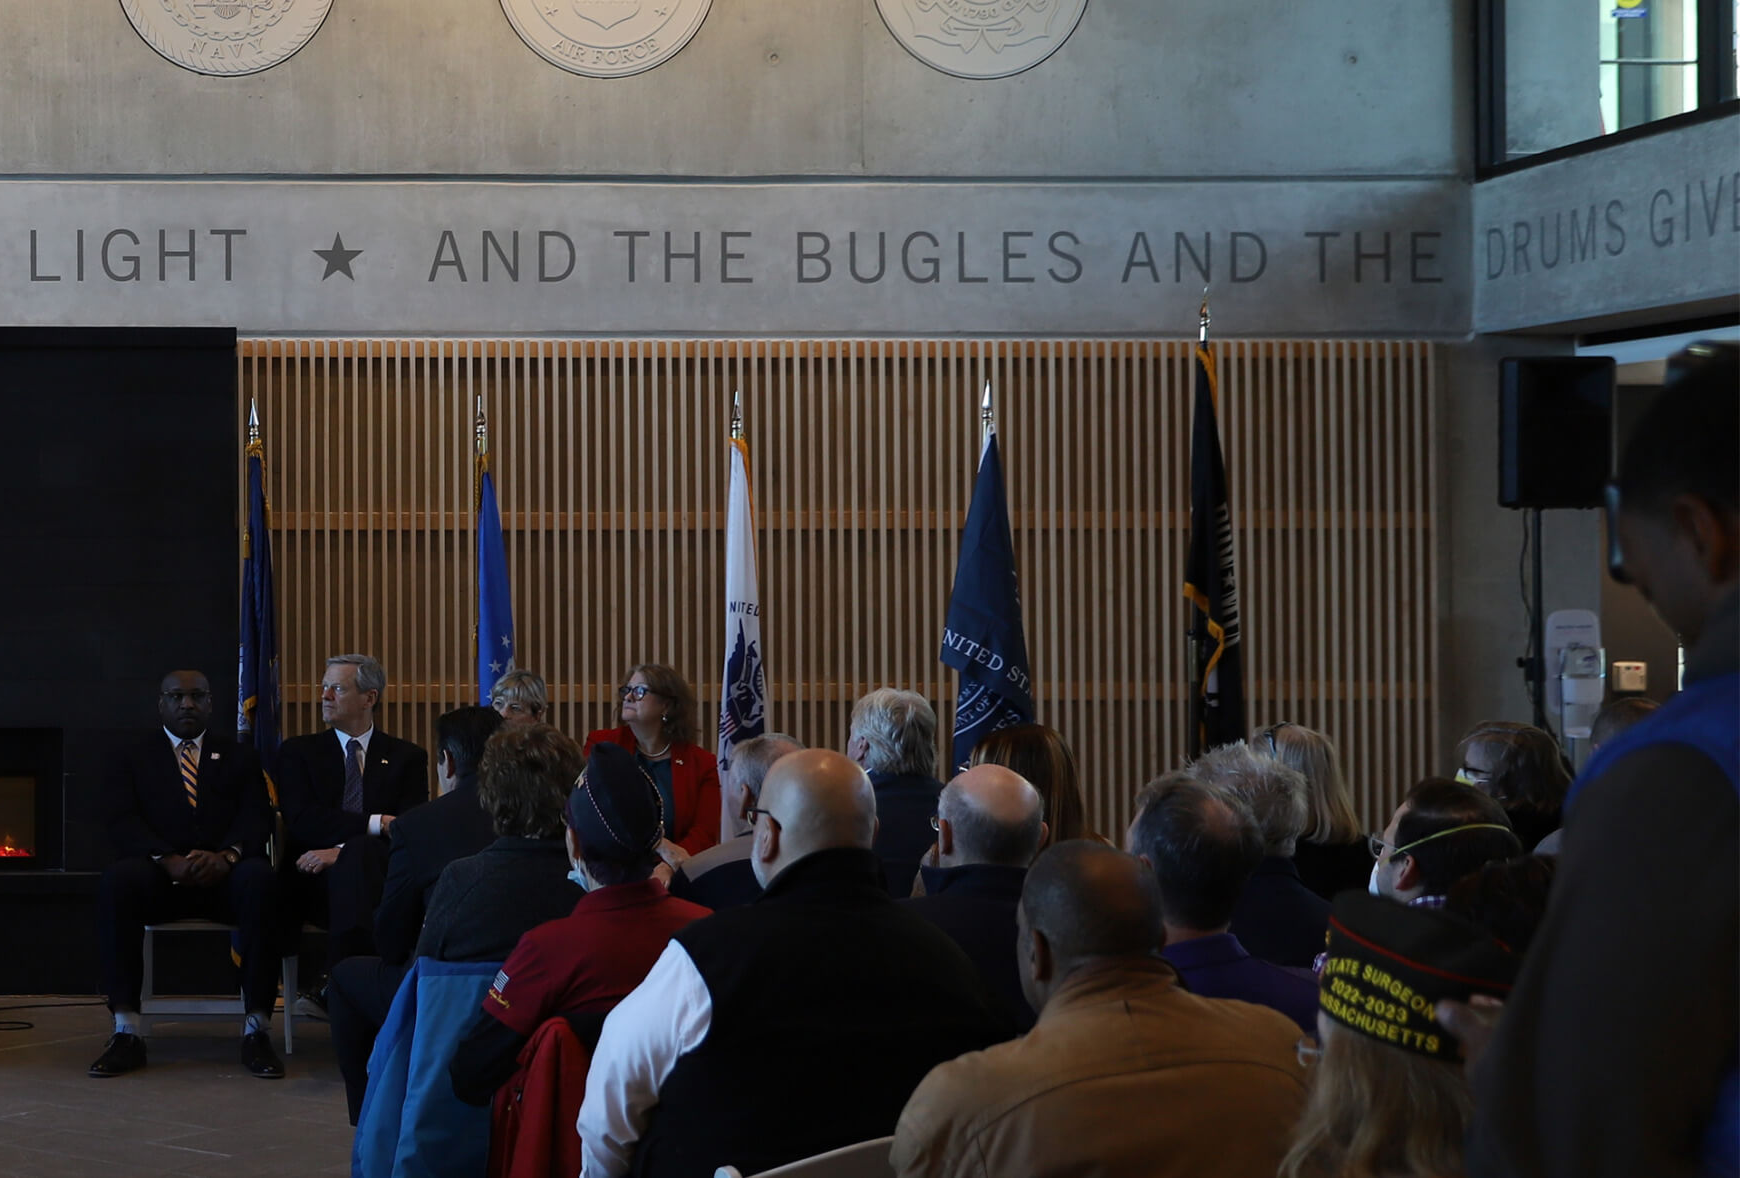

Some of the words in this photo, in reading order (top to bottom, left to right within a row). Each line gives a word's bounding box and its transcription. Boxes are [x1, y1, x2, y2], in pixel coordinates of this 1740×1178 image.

[189, 37, 263, 60] NAVY
[552, 39, 586, 63] AIR
[591, 37, 660, 66] FORCE
[29, 228, 248, 283] LIGHT
[427, 230, 577, 283] AND
[613, 230, 754, 284] THE
[796, 230, 1084, 285] BUGLES
[1120, 230, 1268, 285] AND
[1303, 230, 1445, 285] THE
[1486, 199, 1627, 281] DRUMS
[730, 601, 760, 617] NITED
[943, 627, 1005, 671] NITED
[1325, 957, 1360, 978] STATE
[1361, 963, 1437, 1023] SURGEON
[1330, 976, 1409, 1025] 2022-2023
